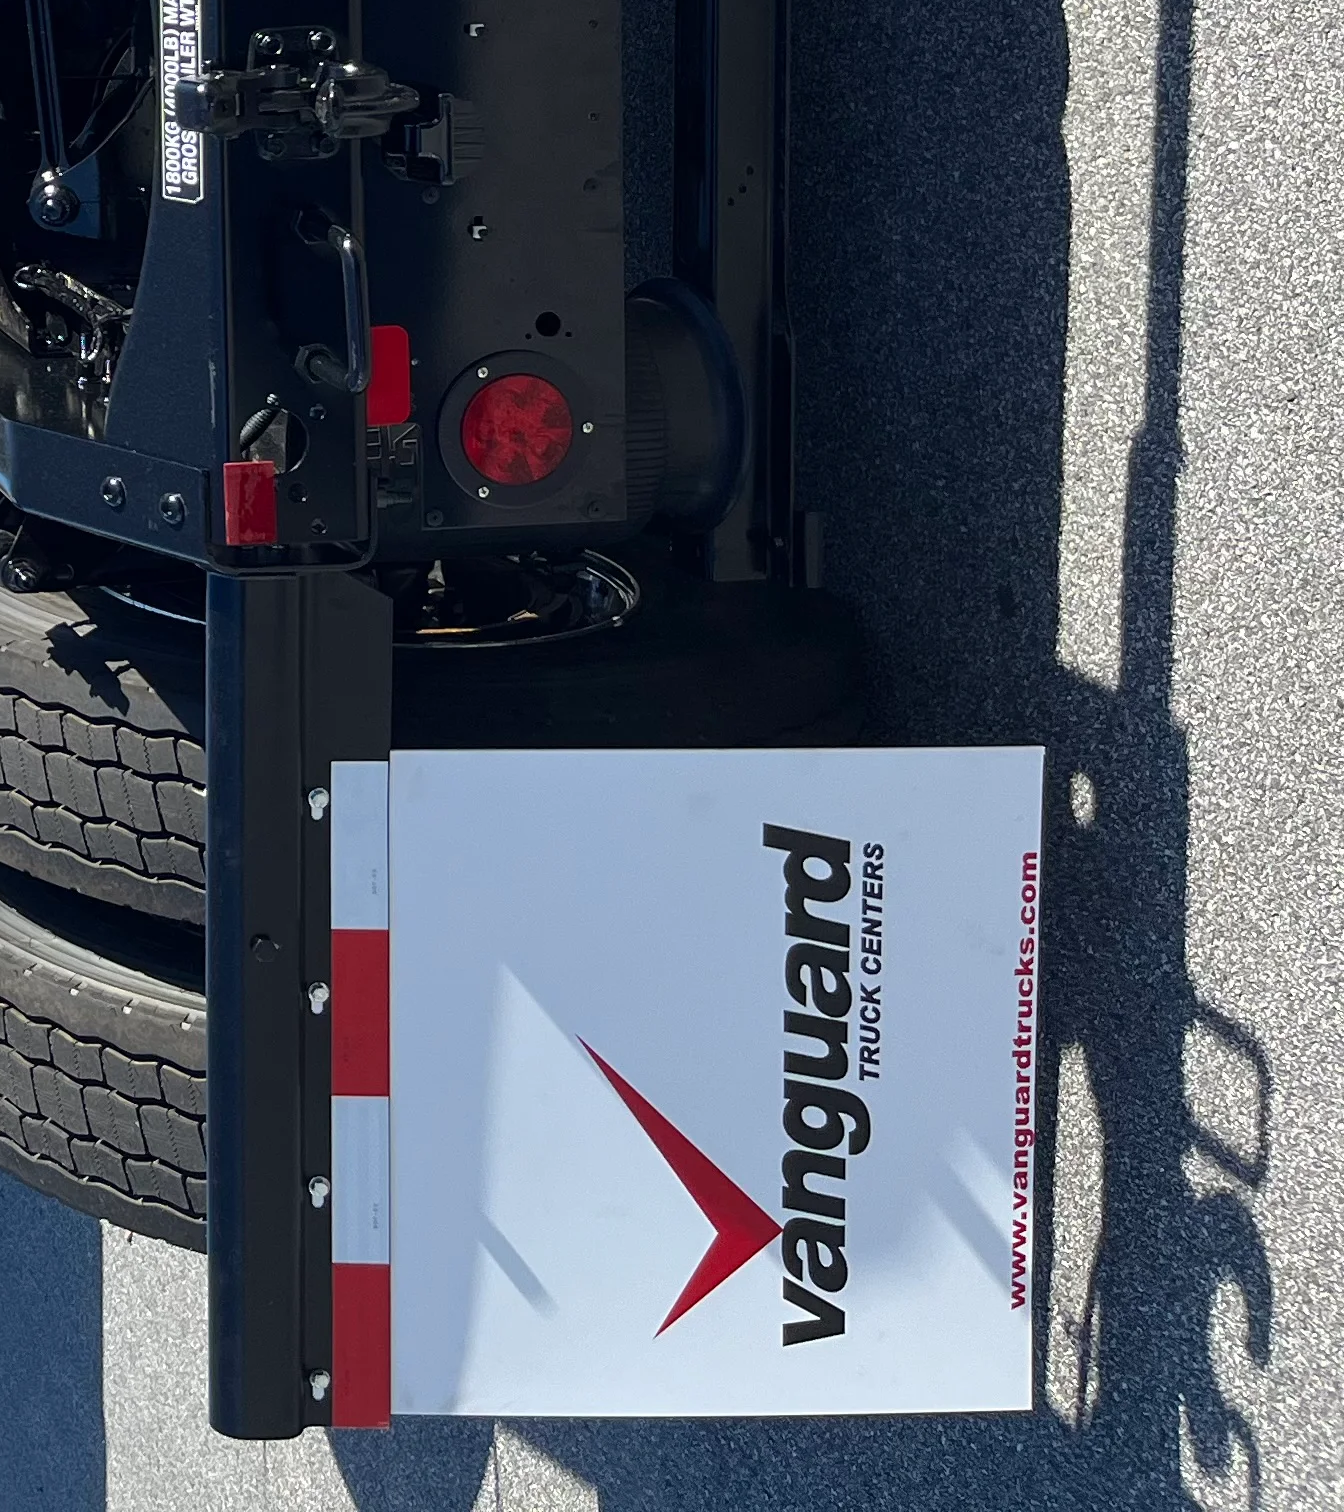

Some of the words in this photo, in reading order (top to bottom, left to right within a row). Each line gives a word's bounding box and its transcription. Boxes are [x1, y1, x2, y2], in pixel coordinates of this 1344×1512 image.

[164, 121, 181, 195] 1800KG
[180, 130, 198, 185] GROS
[860, 842, 885, 975] CENTERS
[763, 823, 872, 1346] vanguard
[859, 983, 882, 1082] TRUCK
[1009, 851, 1039, 1309] www.vanguardtrucks.com
